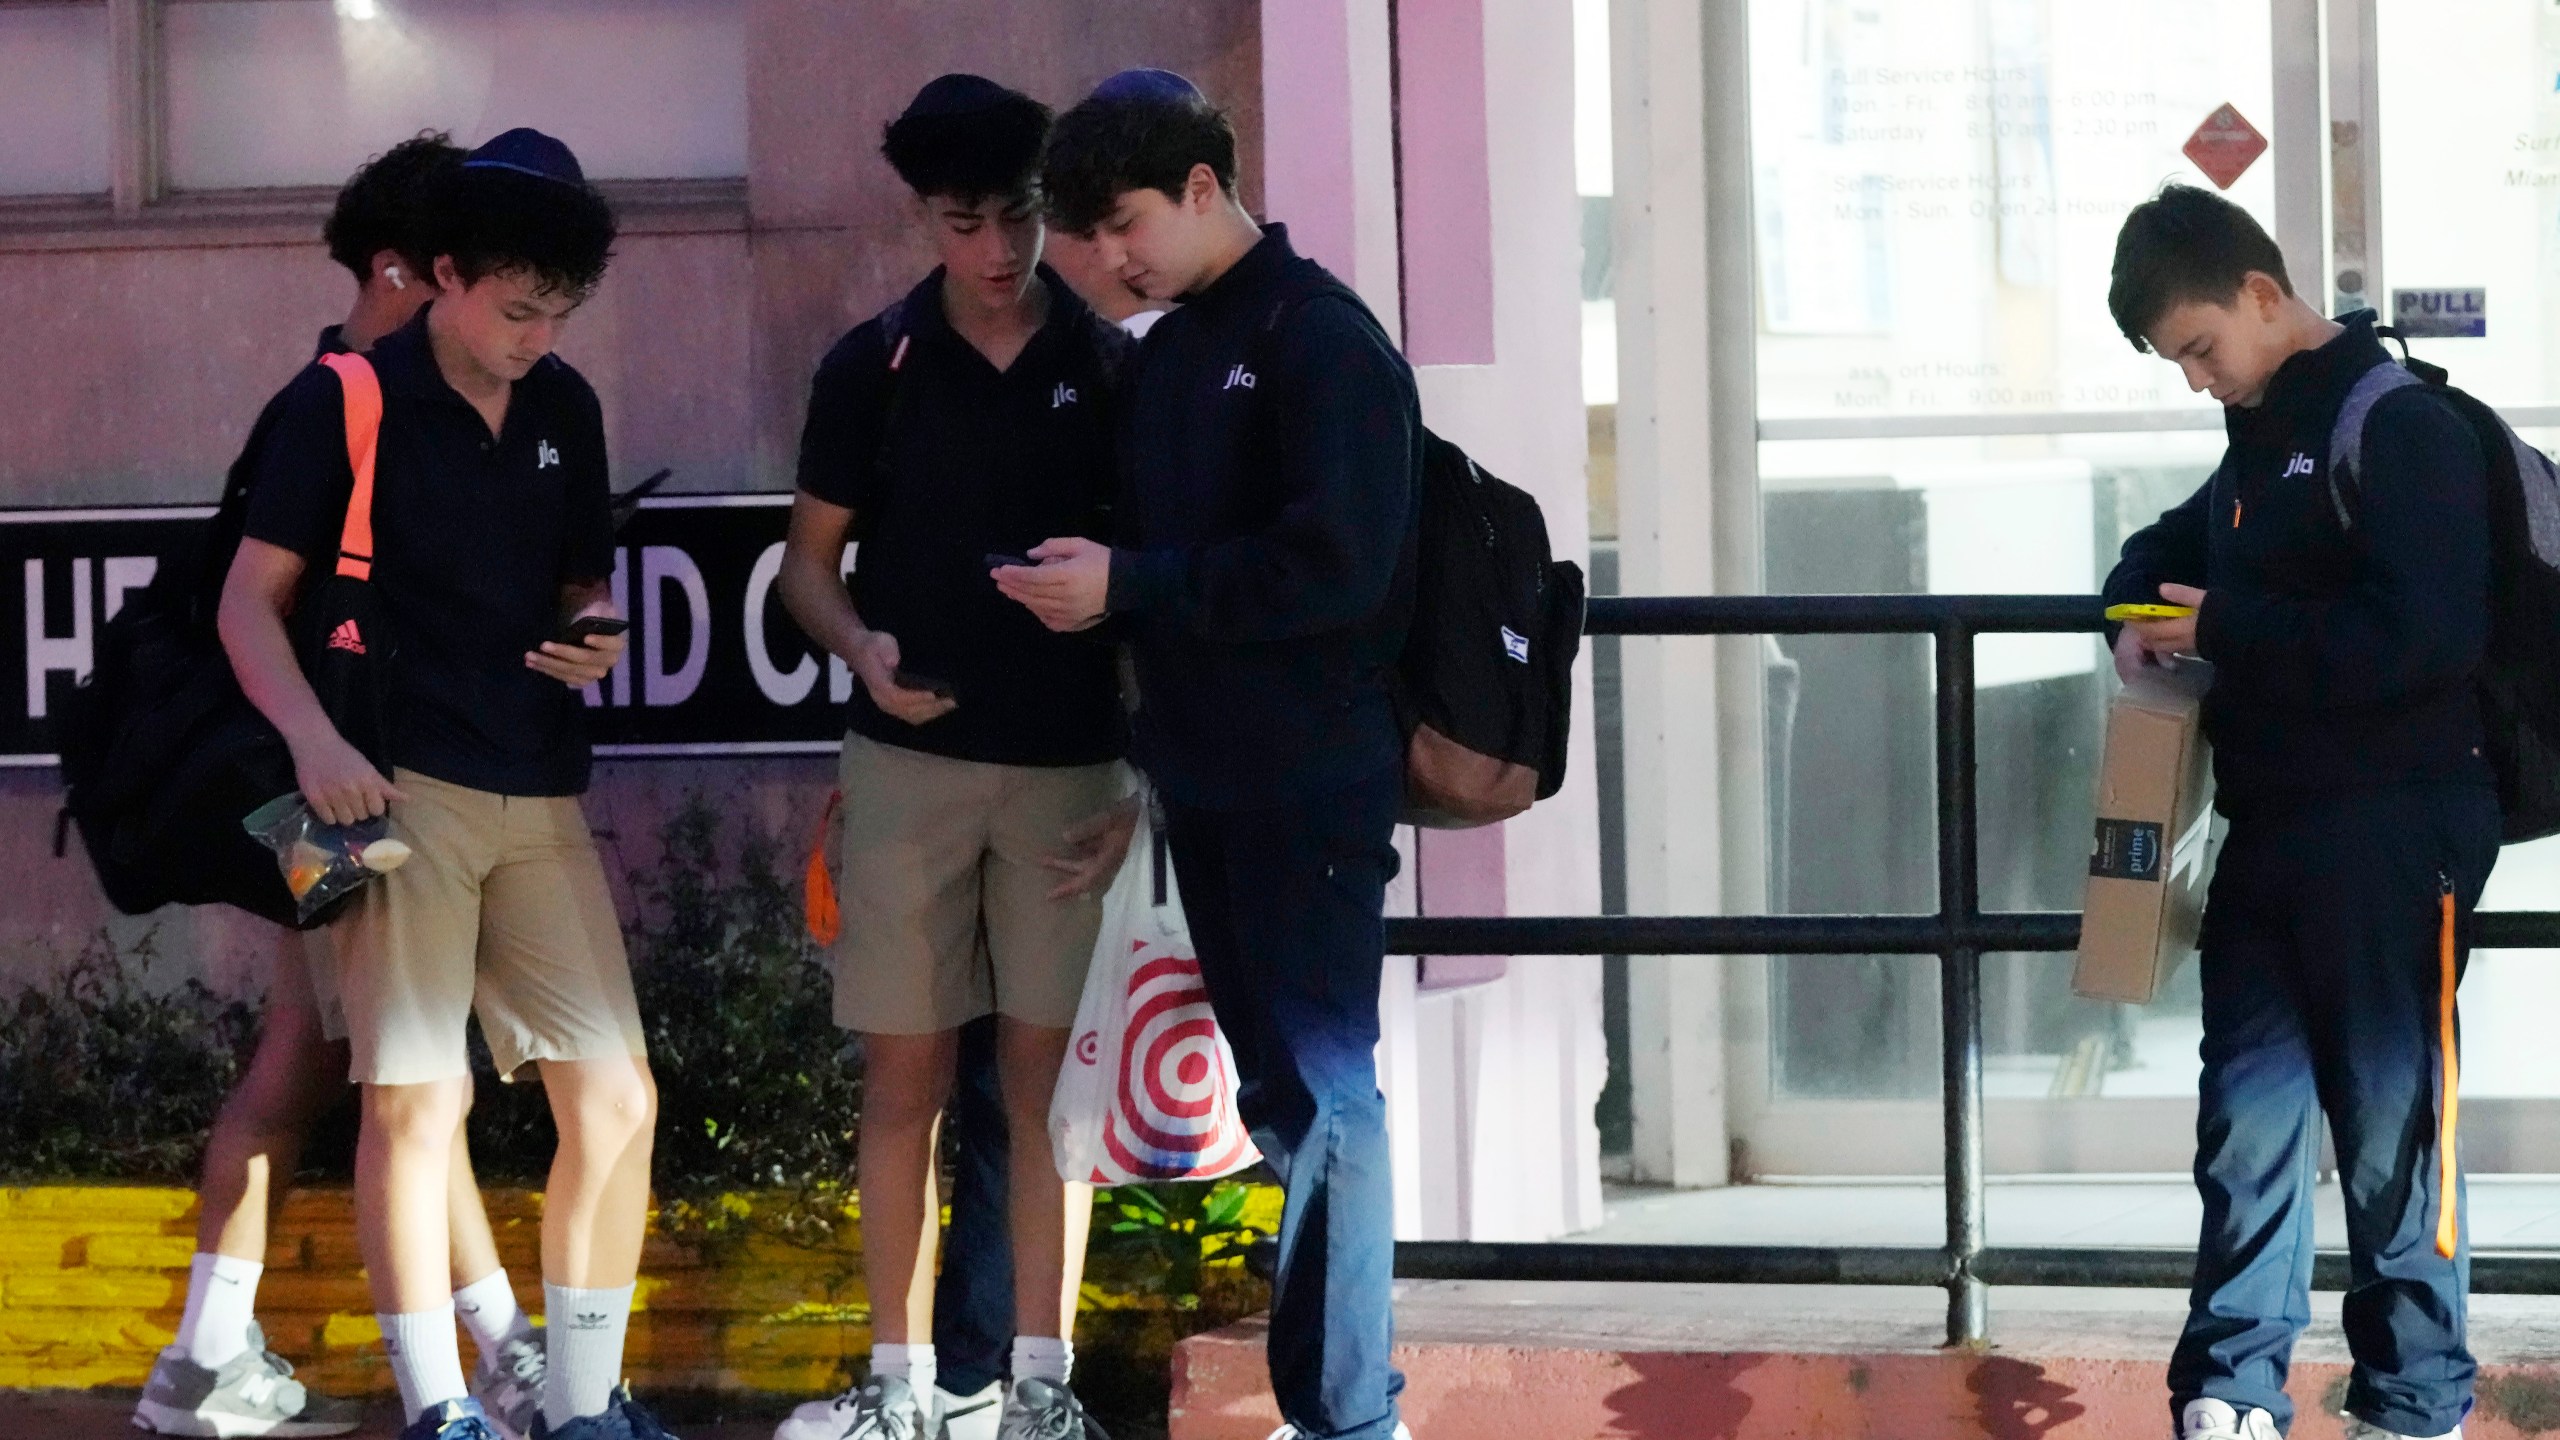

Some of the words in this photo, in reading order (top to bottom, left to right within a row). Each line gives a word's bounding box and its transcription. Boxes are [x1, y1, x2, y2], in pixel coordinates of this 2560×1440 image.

[1876, 66, 1954, 85] Service
[2017, 94, 2049, 110] am
[2071, 90, 2116, 108] 6:00
[2123, 91, 2157, 112] pm
[1831, 123, 1928, 145] Saturday
[2017, 122, 2050, 138] am
[2072, 118, 2117, 136] 2:30
[2124, 119, 2158, 139] pm
[1880, 171, 1960, 191] Service
[1968, 199, 2027, 222] Open
[2034, 195, 2057, 216] 24
[2399, 291, 2481, 314] PULL
[1223, 363, 1257, 389] jla
[1936, 359, 2006, 378] Hours:
[1052, 382, 1078, 408] jla
[1968, 386, 2013, 405] 9:00
[2020, 388, 2054, 404] am
[2073, 384, 2120, 402] 3:00
[2127, 385, 2160, 406] pm
[538, 439, 560, 469] jla
[2282, 452, 2315, 478] jla
[582, 545, 712, 708] ID
[2127, 827, 2145, 873] prime
